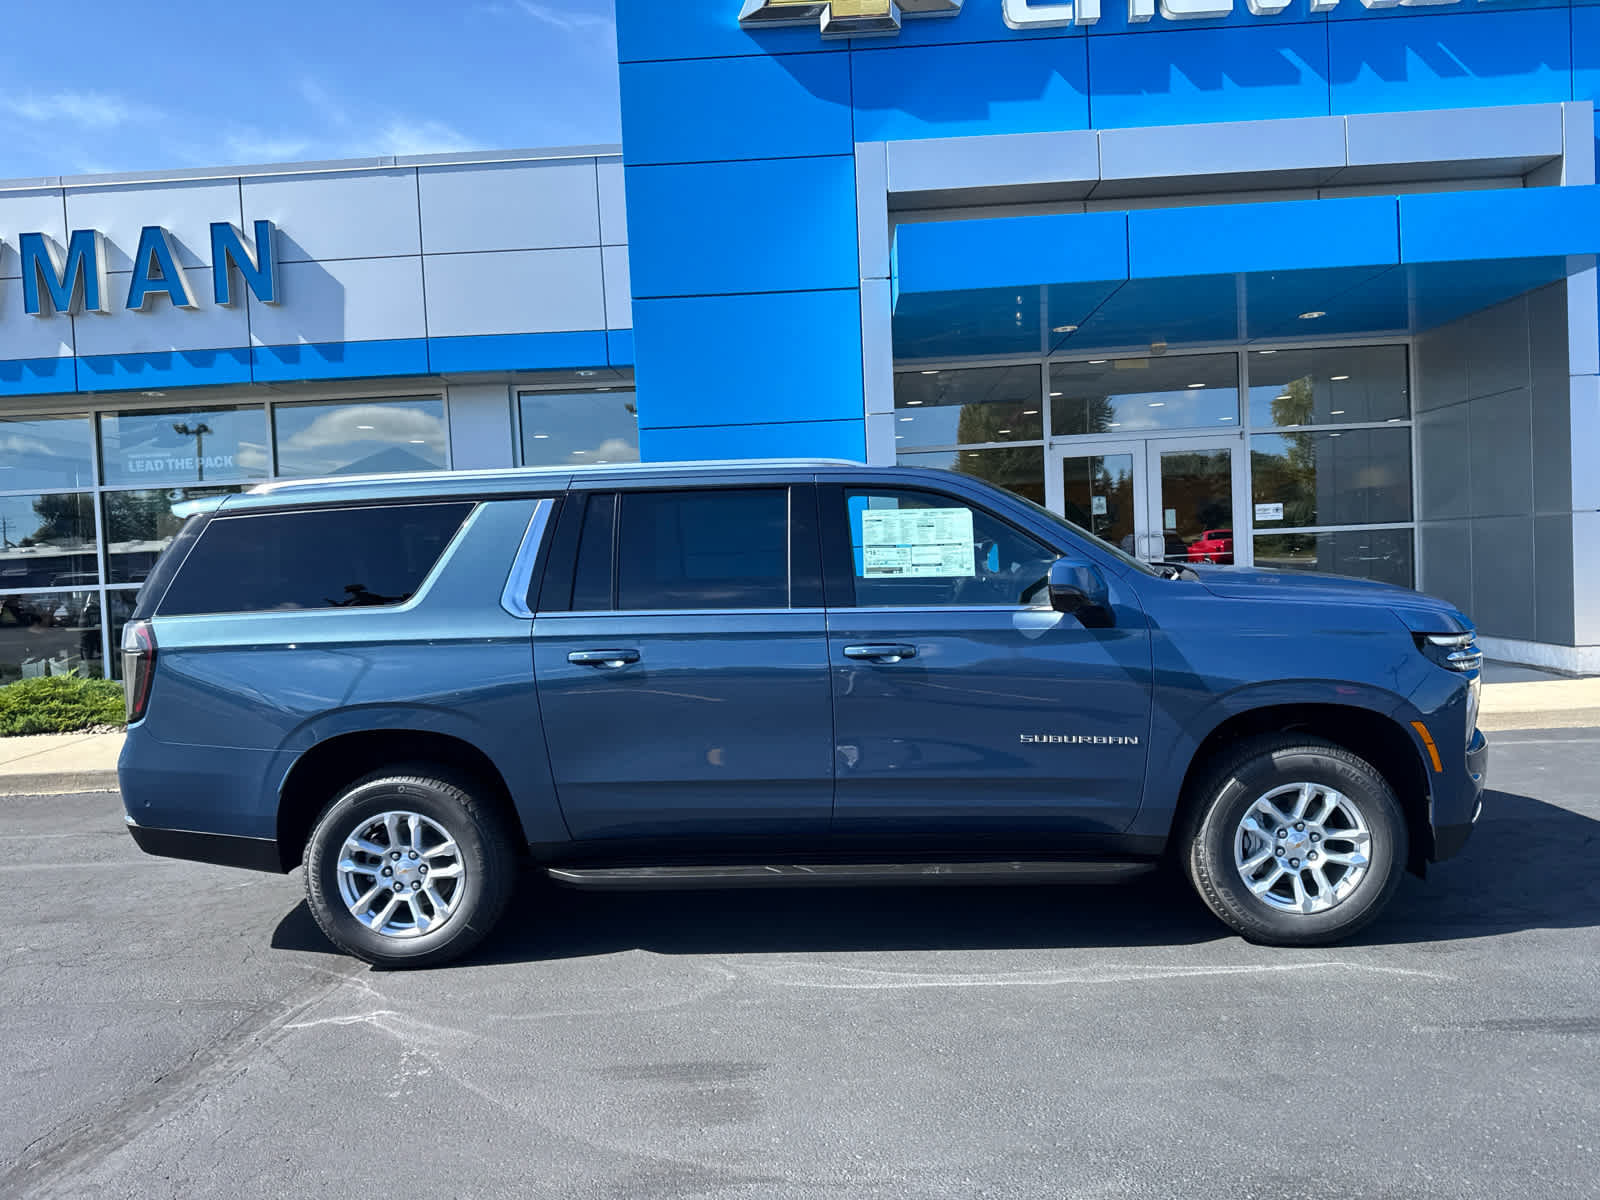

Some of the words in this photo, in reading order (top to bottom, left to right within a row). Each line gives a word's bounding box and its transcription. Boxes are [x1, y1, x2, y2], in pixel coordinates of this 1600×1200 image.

[0, 219, 279, 315] MAN
[128, 459, 164, 473] LEAD
[166, 457, 194, 470] THE
[197, 455, 233, 469] PACK
[1020, 734, 1139, 744] SUBURBAN
